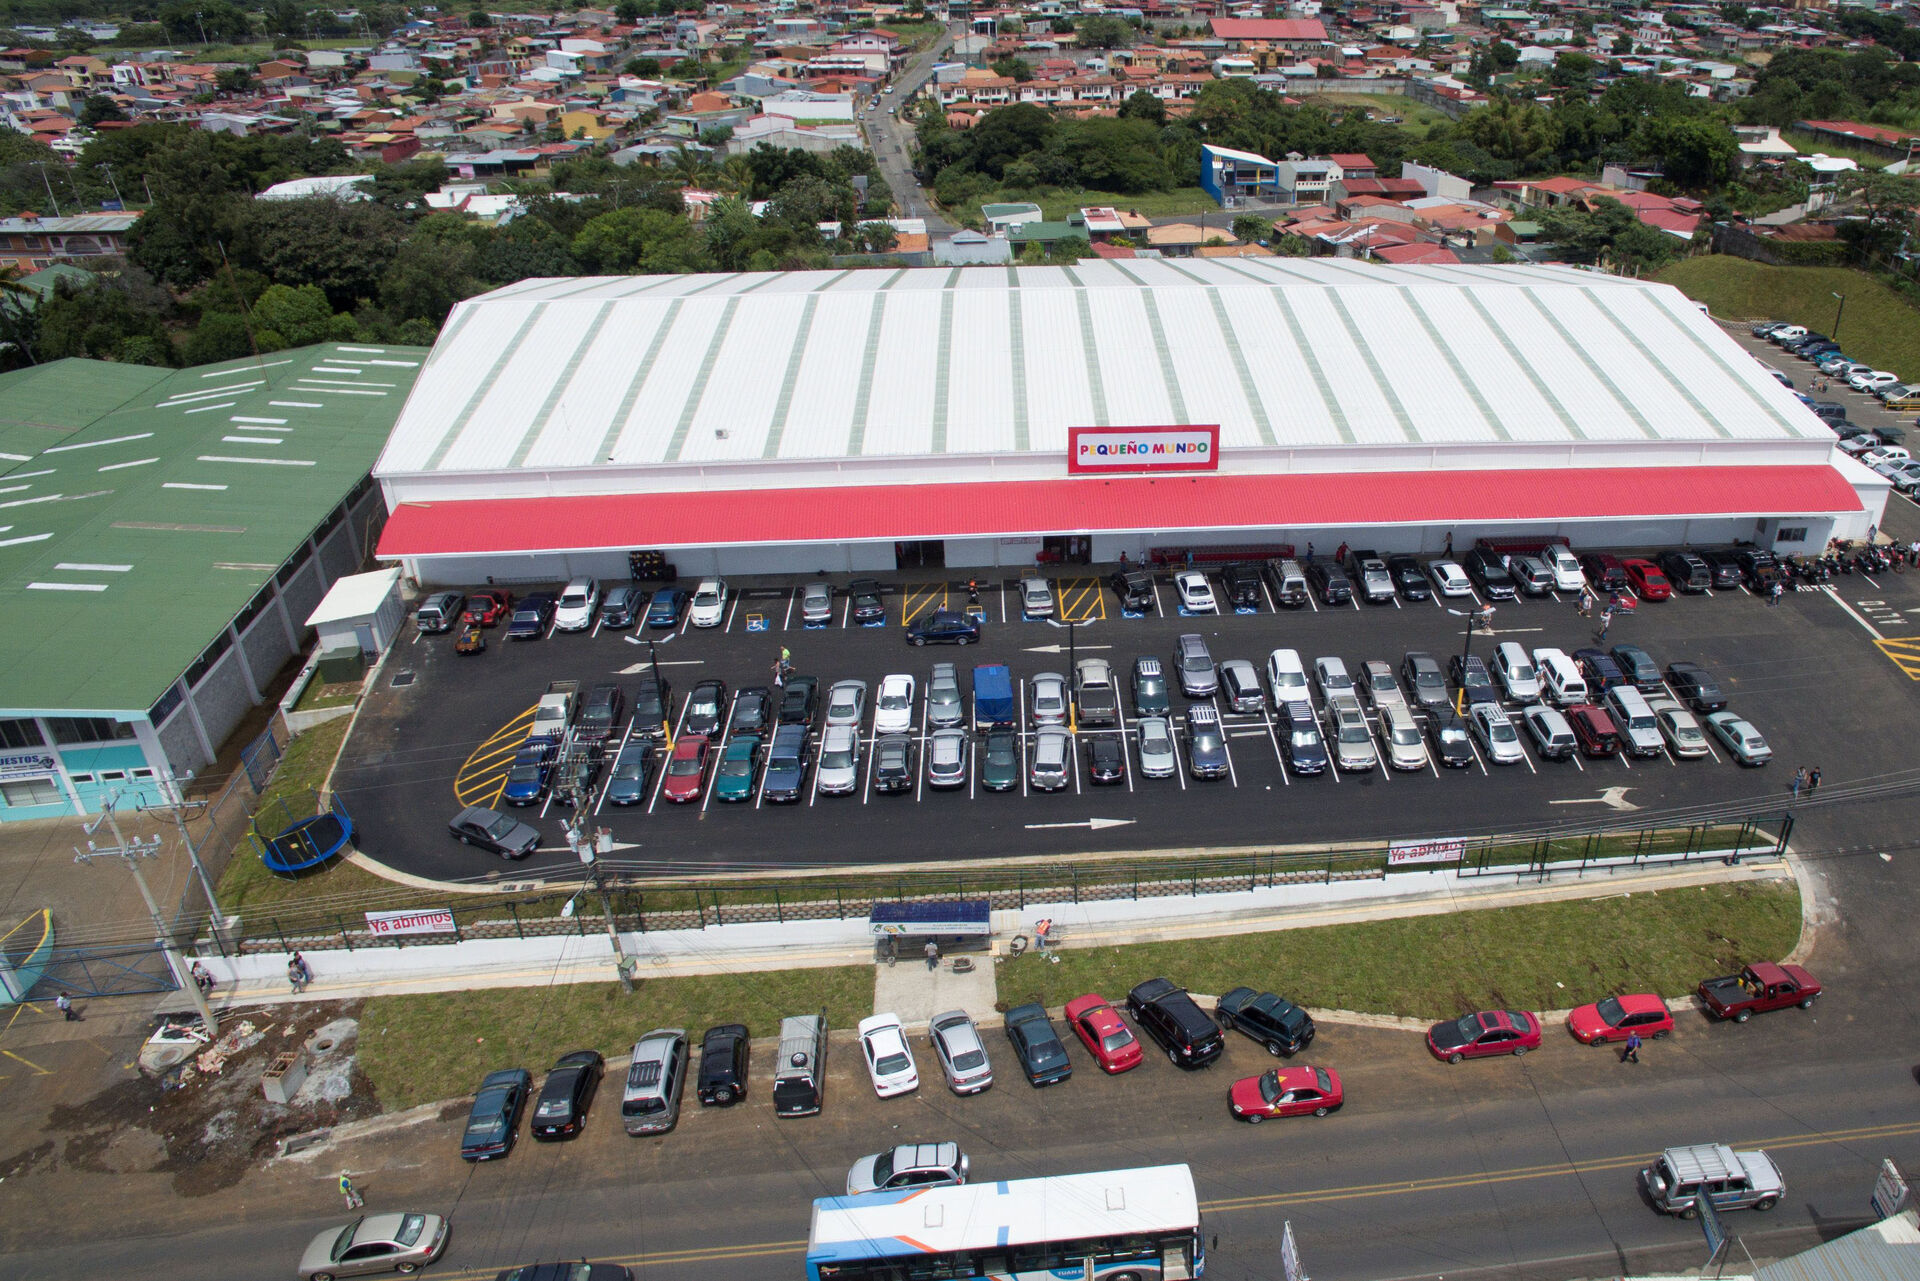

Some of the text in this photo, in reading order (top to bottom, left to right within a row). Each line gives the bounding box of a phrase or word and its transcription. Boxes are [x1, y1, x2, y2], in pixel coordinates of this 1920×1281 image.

[1080, 440, 1208, 456] PEQUEÑO MUNDO
[1391, 848, 1405, 862] Ya
[370, 912, 452, 933] Ya abrimos
